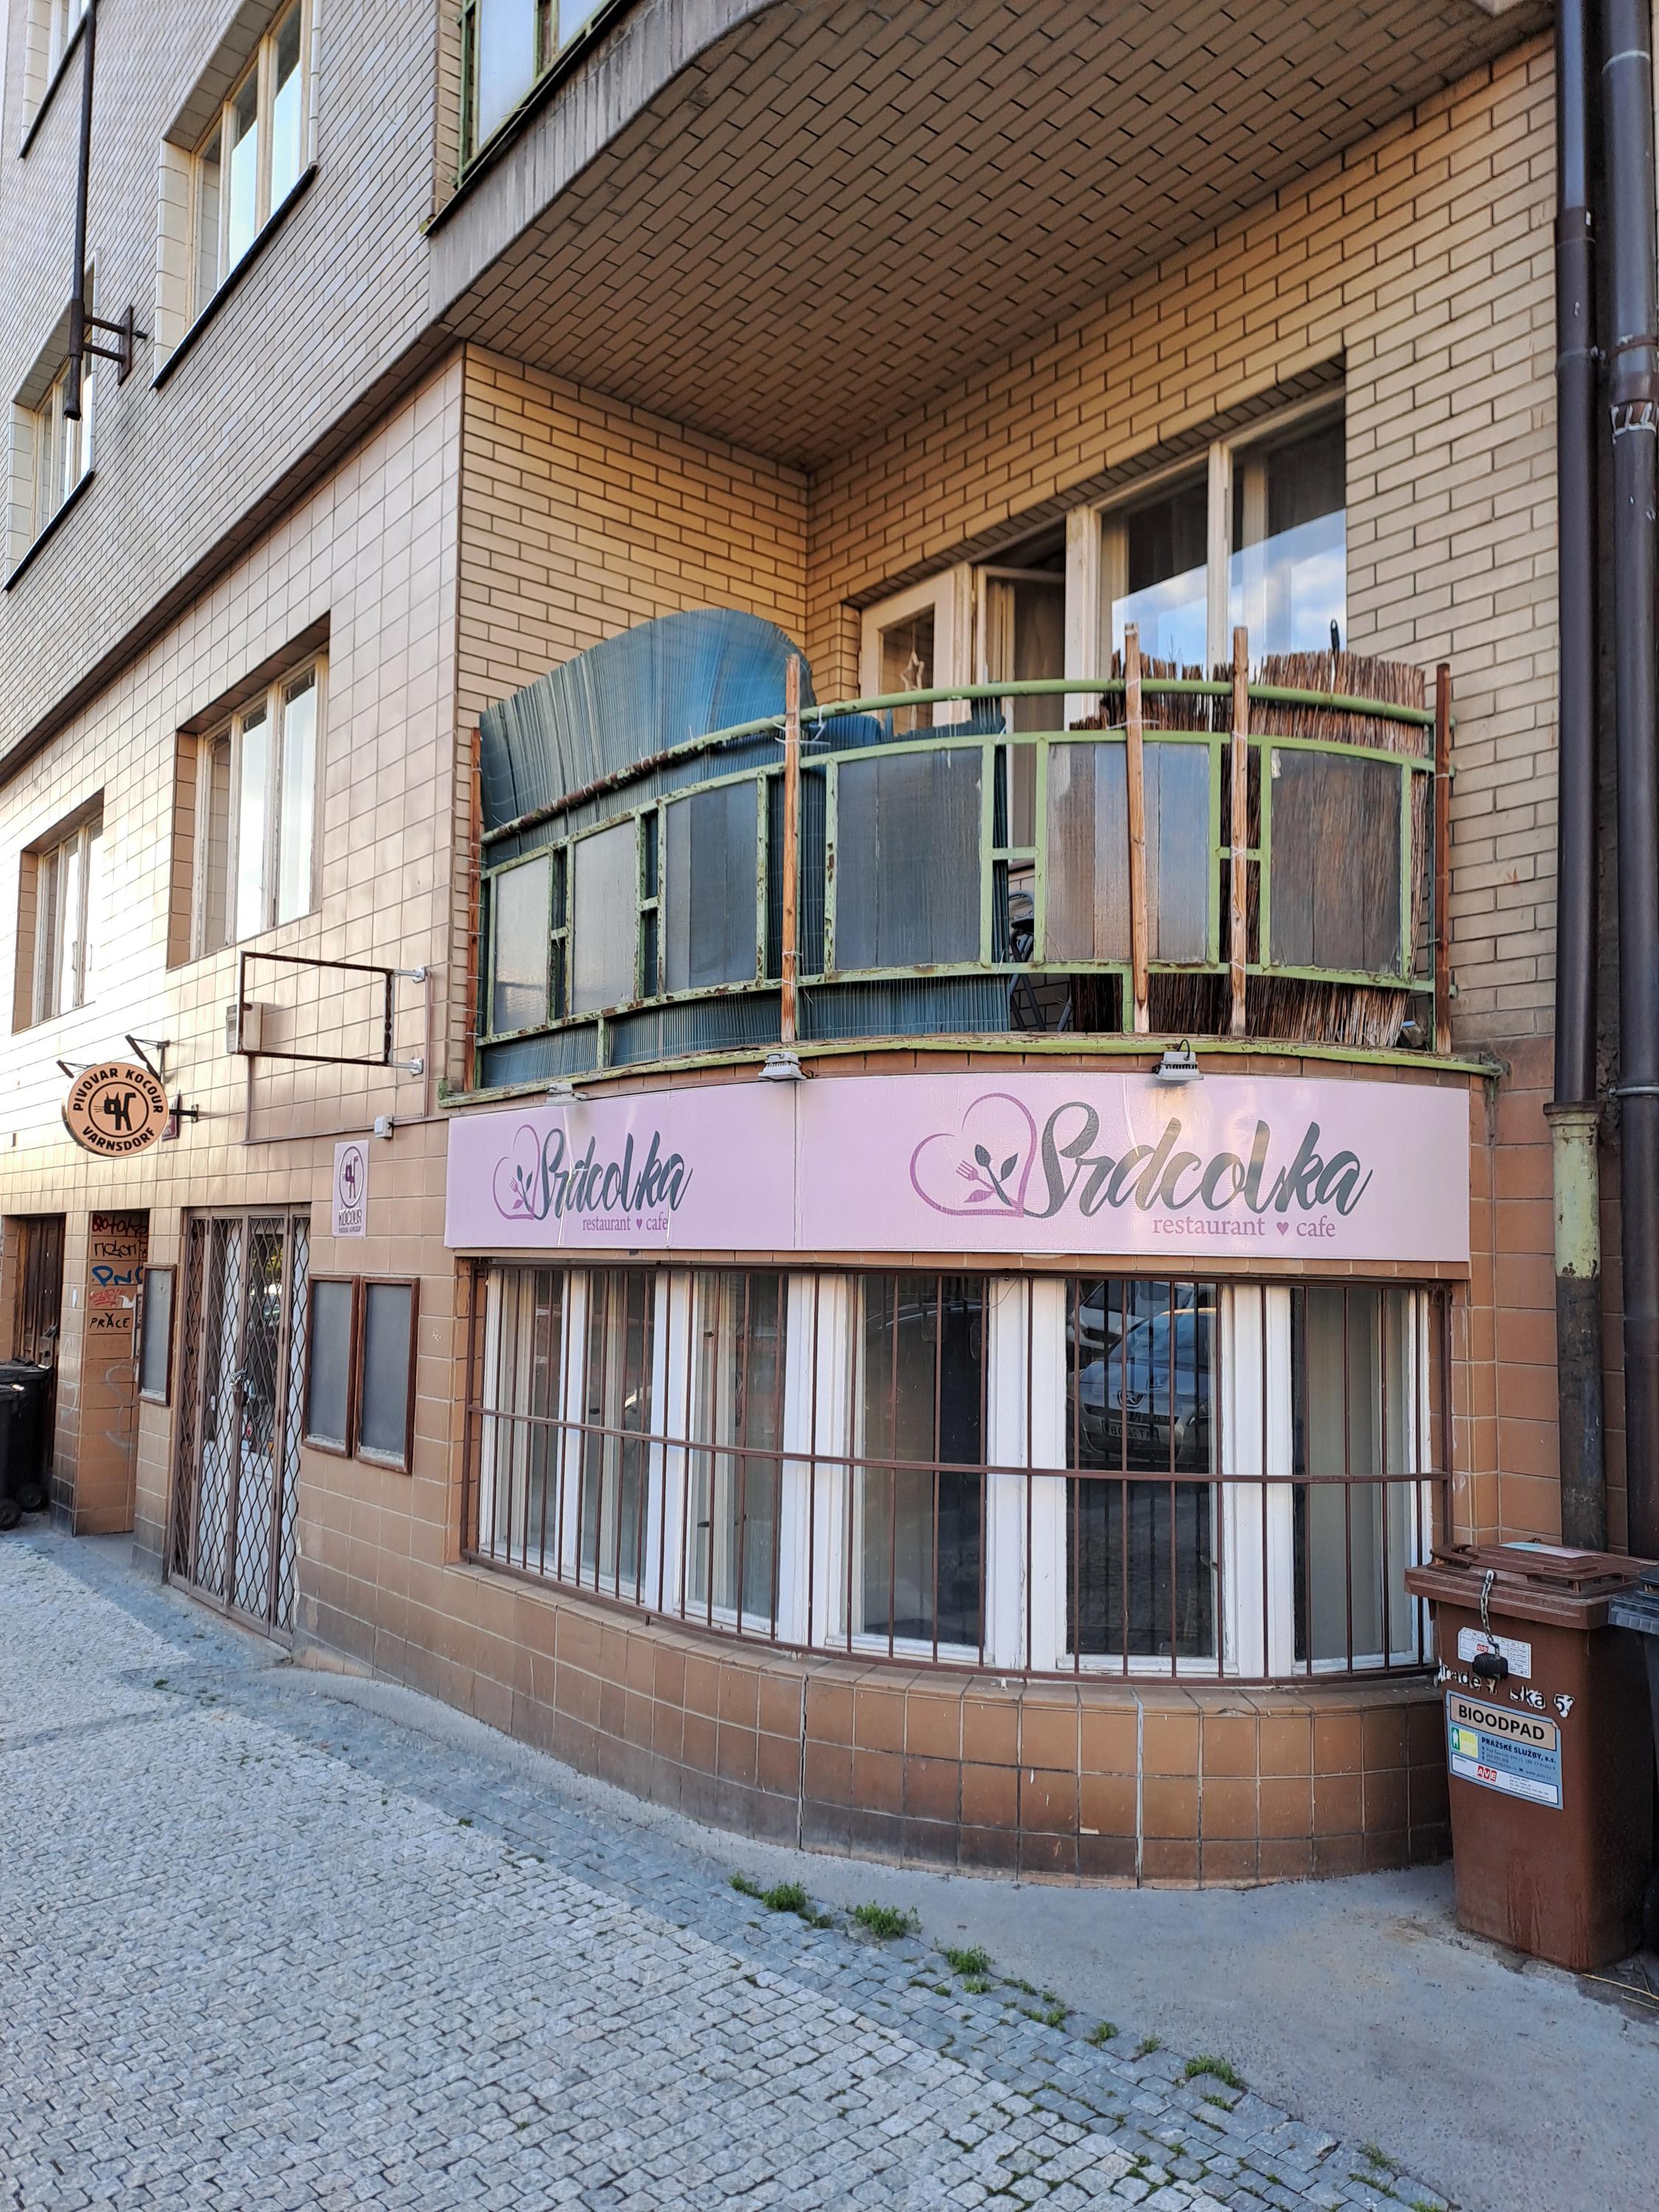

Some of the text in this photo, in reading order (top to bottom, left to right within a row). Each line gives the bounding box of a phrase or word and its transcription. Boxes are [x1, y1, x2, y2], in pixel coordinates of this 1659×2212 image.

[73, 1068, 164, 1114] PIVOVAR KOCOUR
[82, 1126, 156, 1152] VARNSDORF
[338, 1208, 362, 1227] KOCOUR
[582, 1211, 668, 1231] restaurant cafe
[1152, 1215, 1337, 1238] restaurant cafe
[1458, 1705, 1545, 1740] BIOODPAD
[1477, 1765, 1498, 1782] AVE
